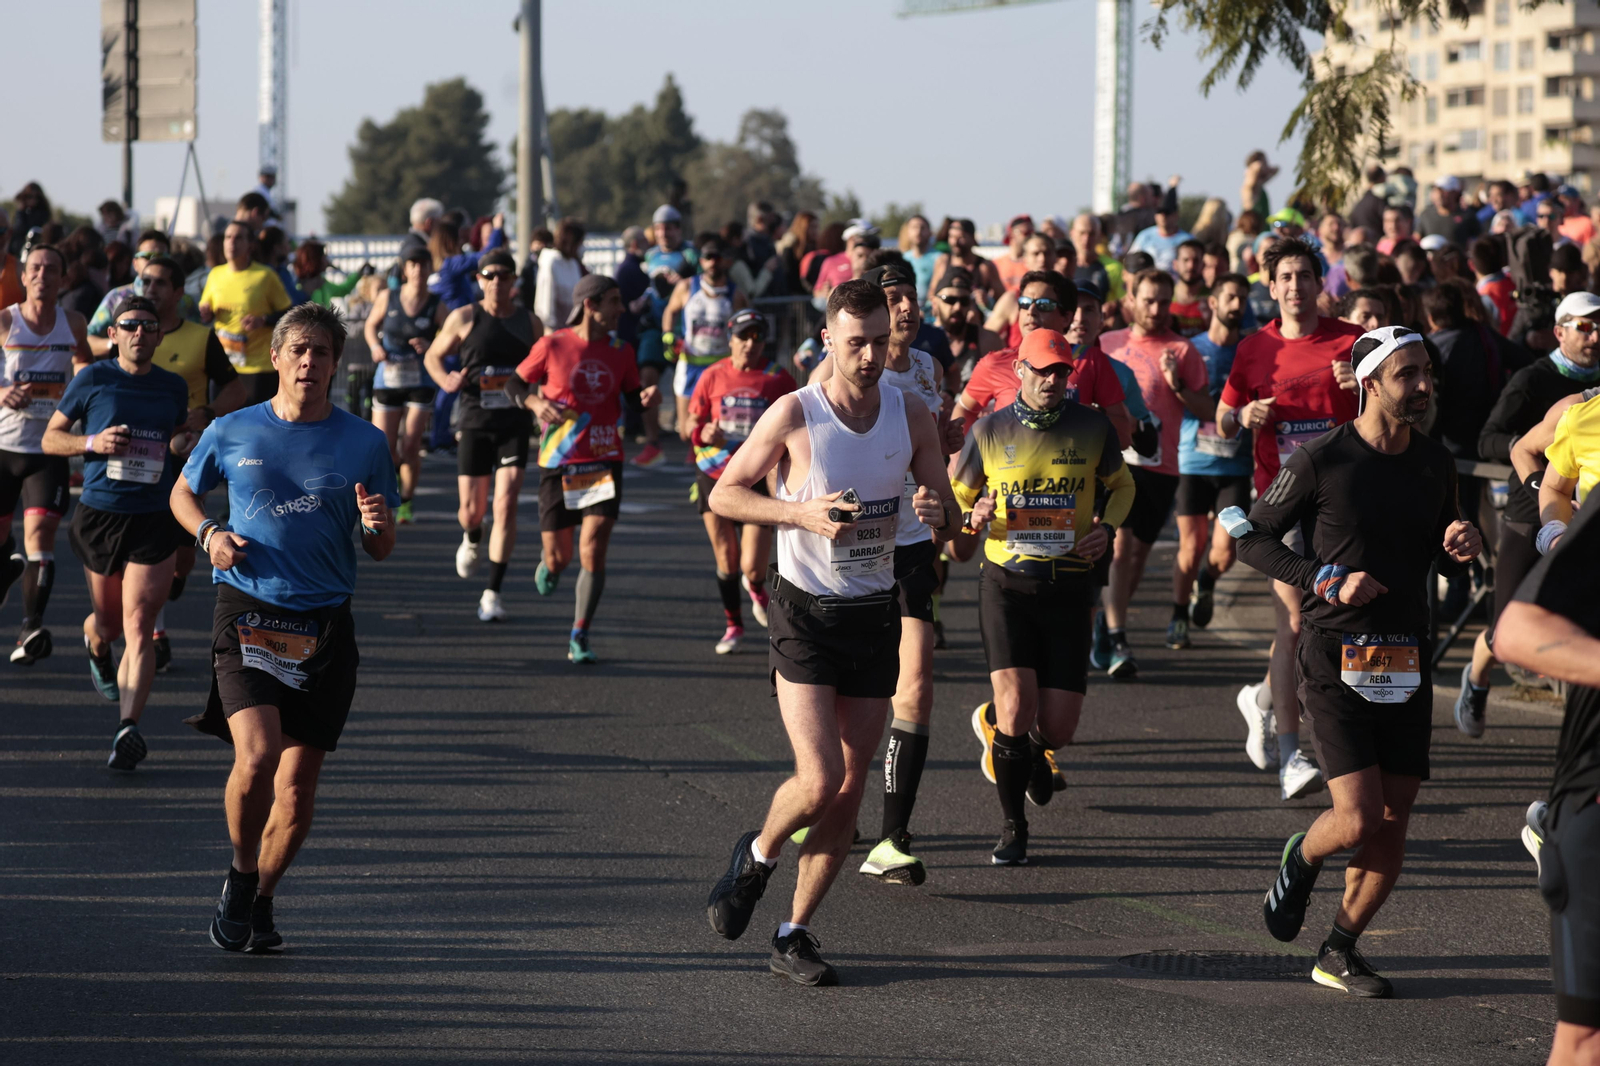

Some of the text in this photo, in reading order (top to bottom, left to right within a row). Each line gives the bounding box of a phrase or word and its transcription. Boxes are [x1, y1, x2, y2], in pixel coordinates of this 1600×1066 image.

[1293, 421, 1328, 432] ZURICH
[131, 429, 162, 439] ZURICH
[129, 446, 149, 456] 7140
[128, 460, 145, 468] PJVC
[1028, 497, 1068, 506] ZURICH
[864, 501, 895, 516] URICH
[1028, 516, 1052, 527] 5005
[856, 527, 881, 541] 9283
[1014, 532, 1066, 540] JAVIER SEGUI
[849, 544, 885, 558] DARRAGH
[263, 618, 309, 632] ZURICH
[244, 646, 274, 662] MIGUEL
[1370, 656, 1392, 667] 5647
[1369, 675, 1392, 684] REDA
